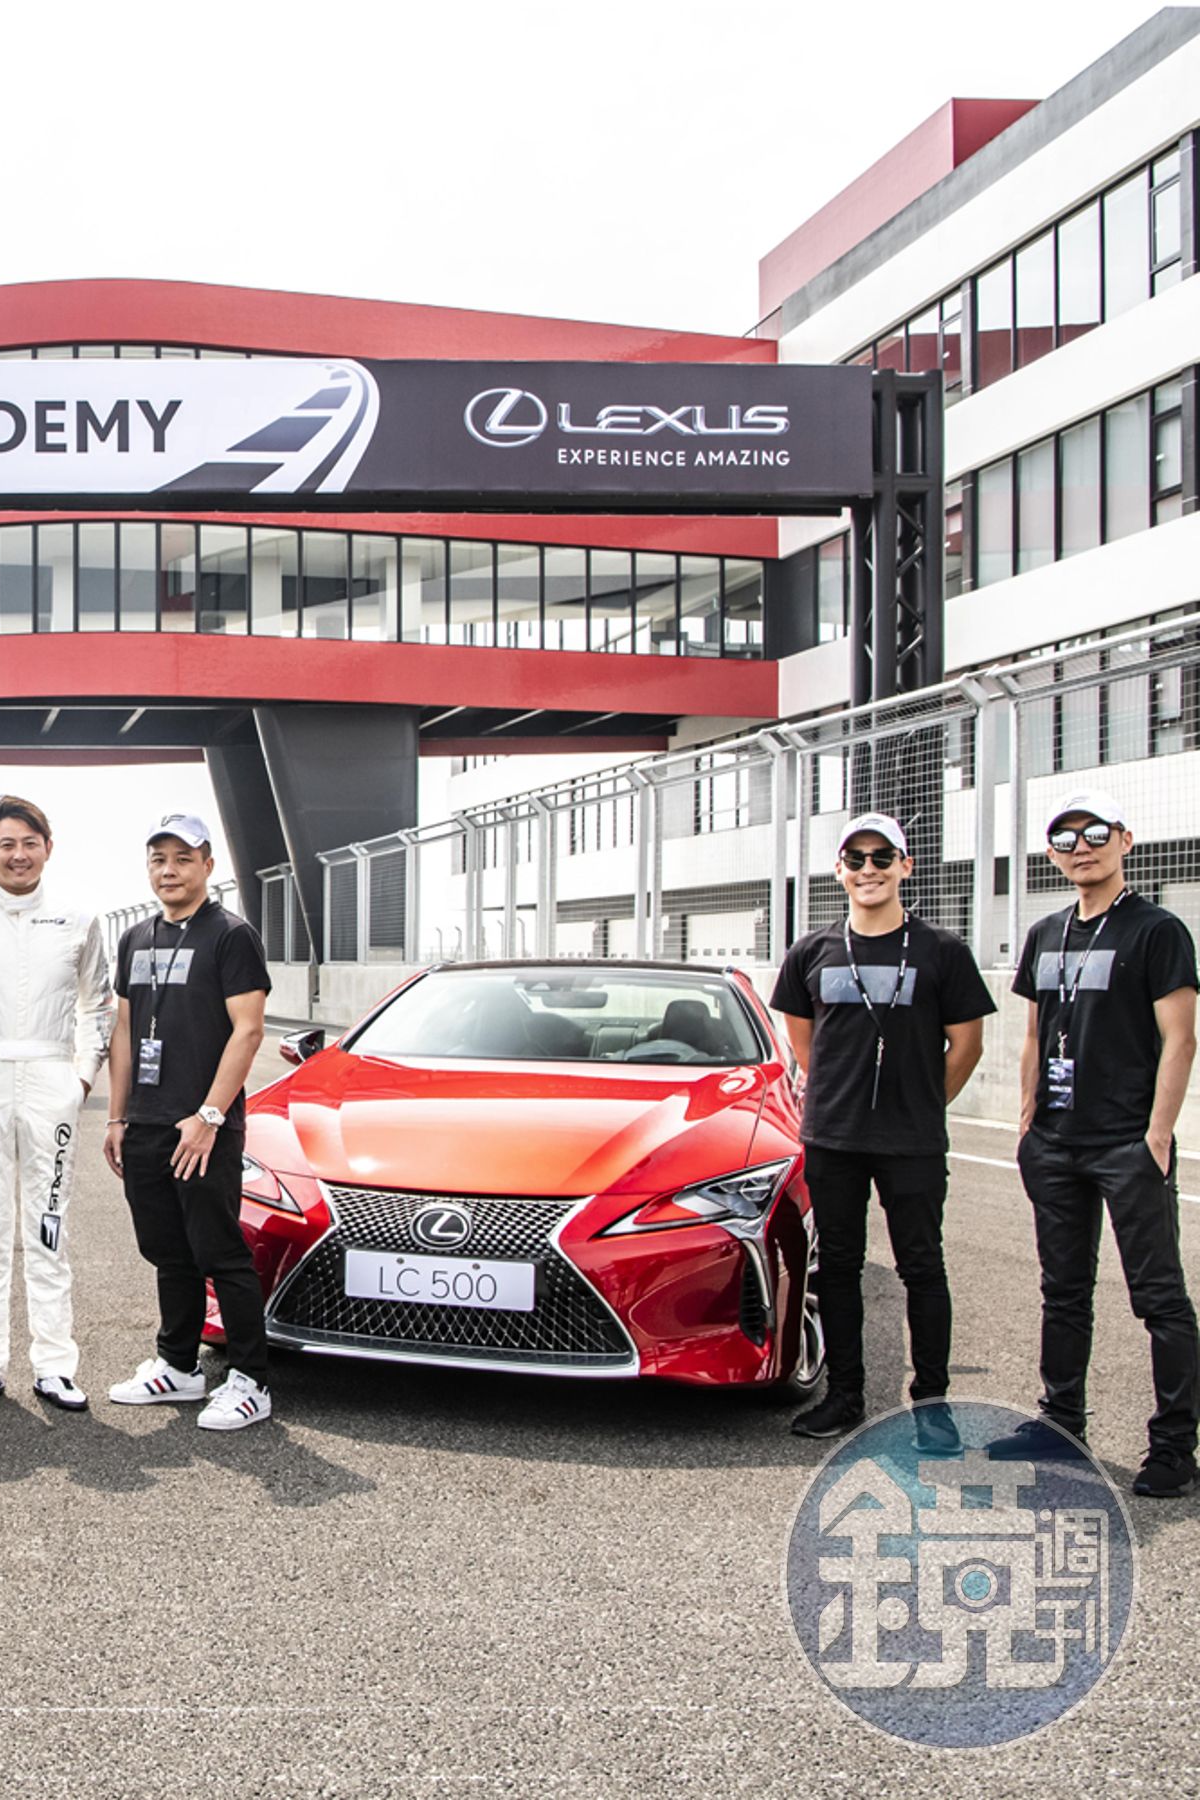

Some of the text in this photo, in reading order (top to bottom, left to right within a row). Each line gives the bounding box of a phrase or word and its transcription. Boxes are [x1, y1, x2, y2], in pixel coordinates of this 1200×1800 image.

[557, 402, 791, 436] LEXUS
[557, 448, 792, 467] EXPERIENCE AMAZING
[378, 1266, 497, 1303] LC 500
